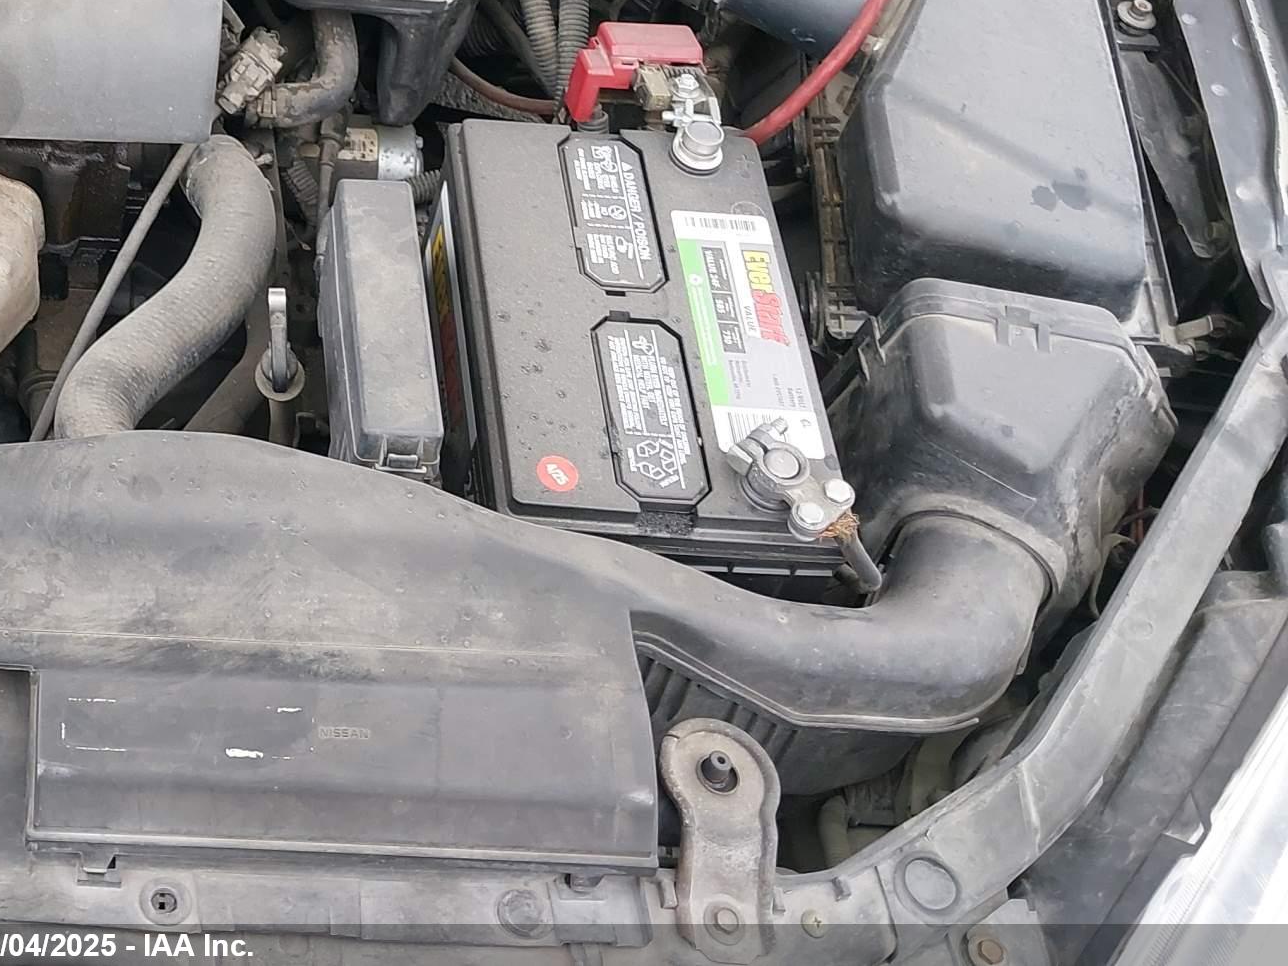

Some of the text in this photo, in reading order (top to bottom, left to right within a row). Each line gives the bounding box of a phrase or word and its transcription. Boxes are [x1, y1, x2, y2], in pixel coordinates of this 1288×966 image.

[623, 172, 642, 212] DANGER
[634, 221, 652, 260] POISON
[703, 250, 717, 273] VALUE
[741, 250, 791, 346] EverStart
[742, 305, 756, 331] VALUE
[318, 725, 370, 740] NISSAN
